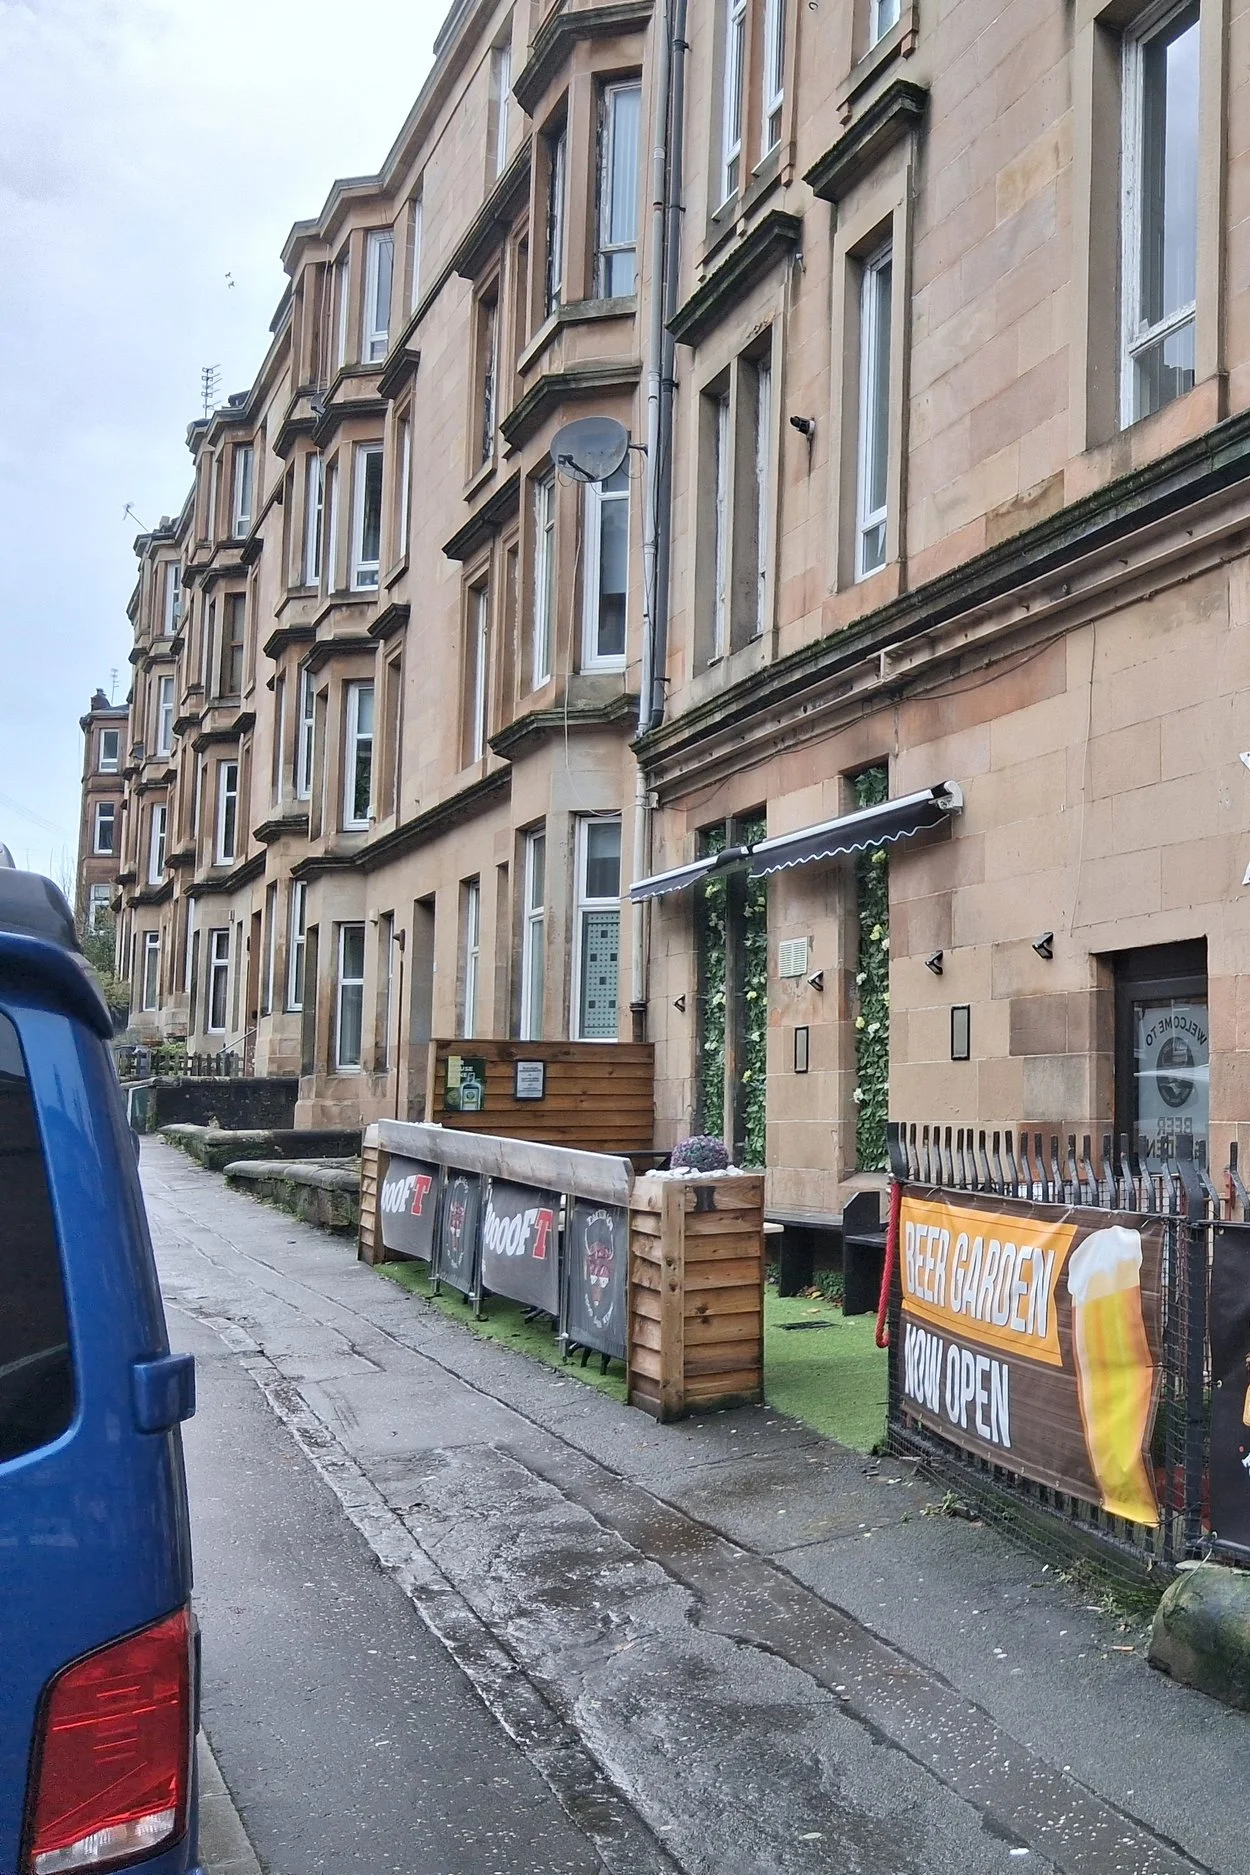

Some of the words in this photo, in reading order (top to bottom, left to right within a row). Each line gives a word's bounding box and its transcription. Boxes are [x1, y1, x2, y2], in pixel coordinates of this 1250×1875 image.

[905, 1221, 951, 1307] BEER
[950, 1231, 1056, 1340] GARDEN
[904, 1323, 944, 1415] NOW
[945, 1343, 1012, 1449] OPEN
